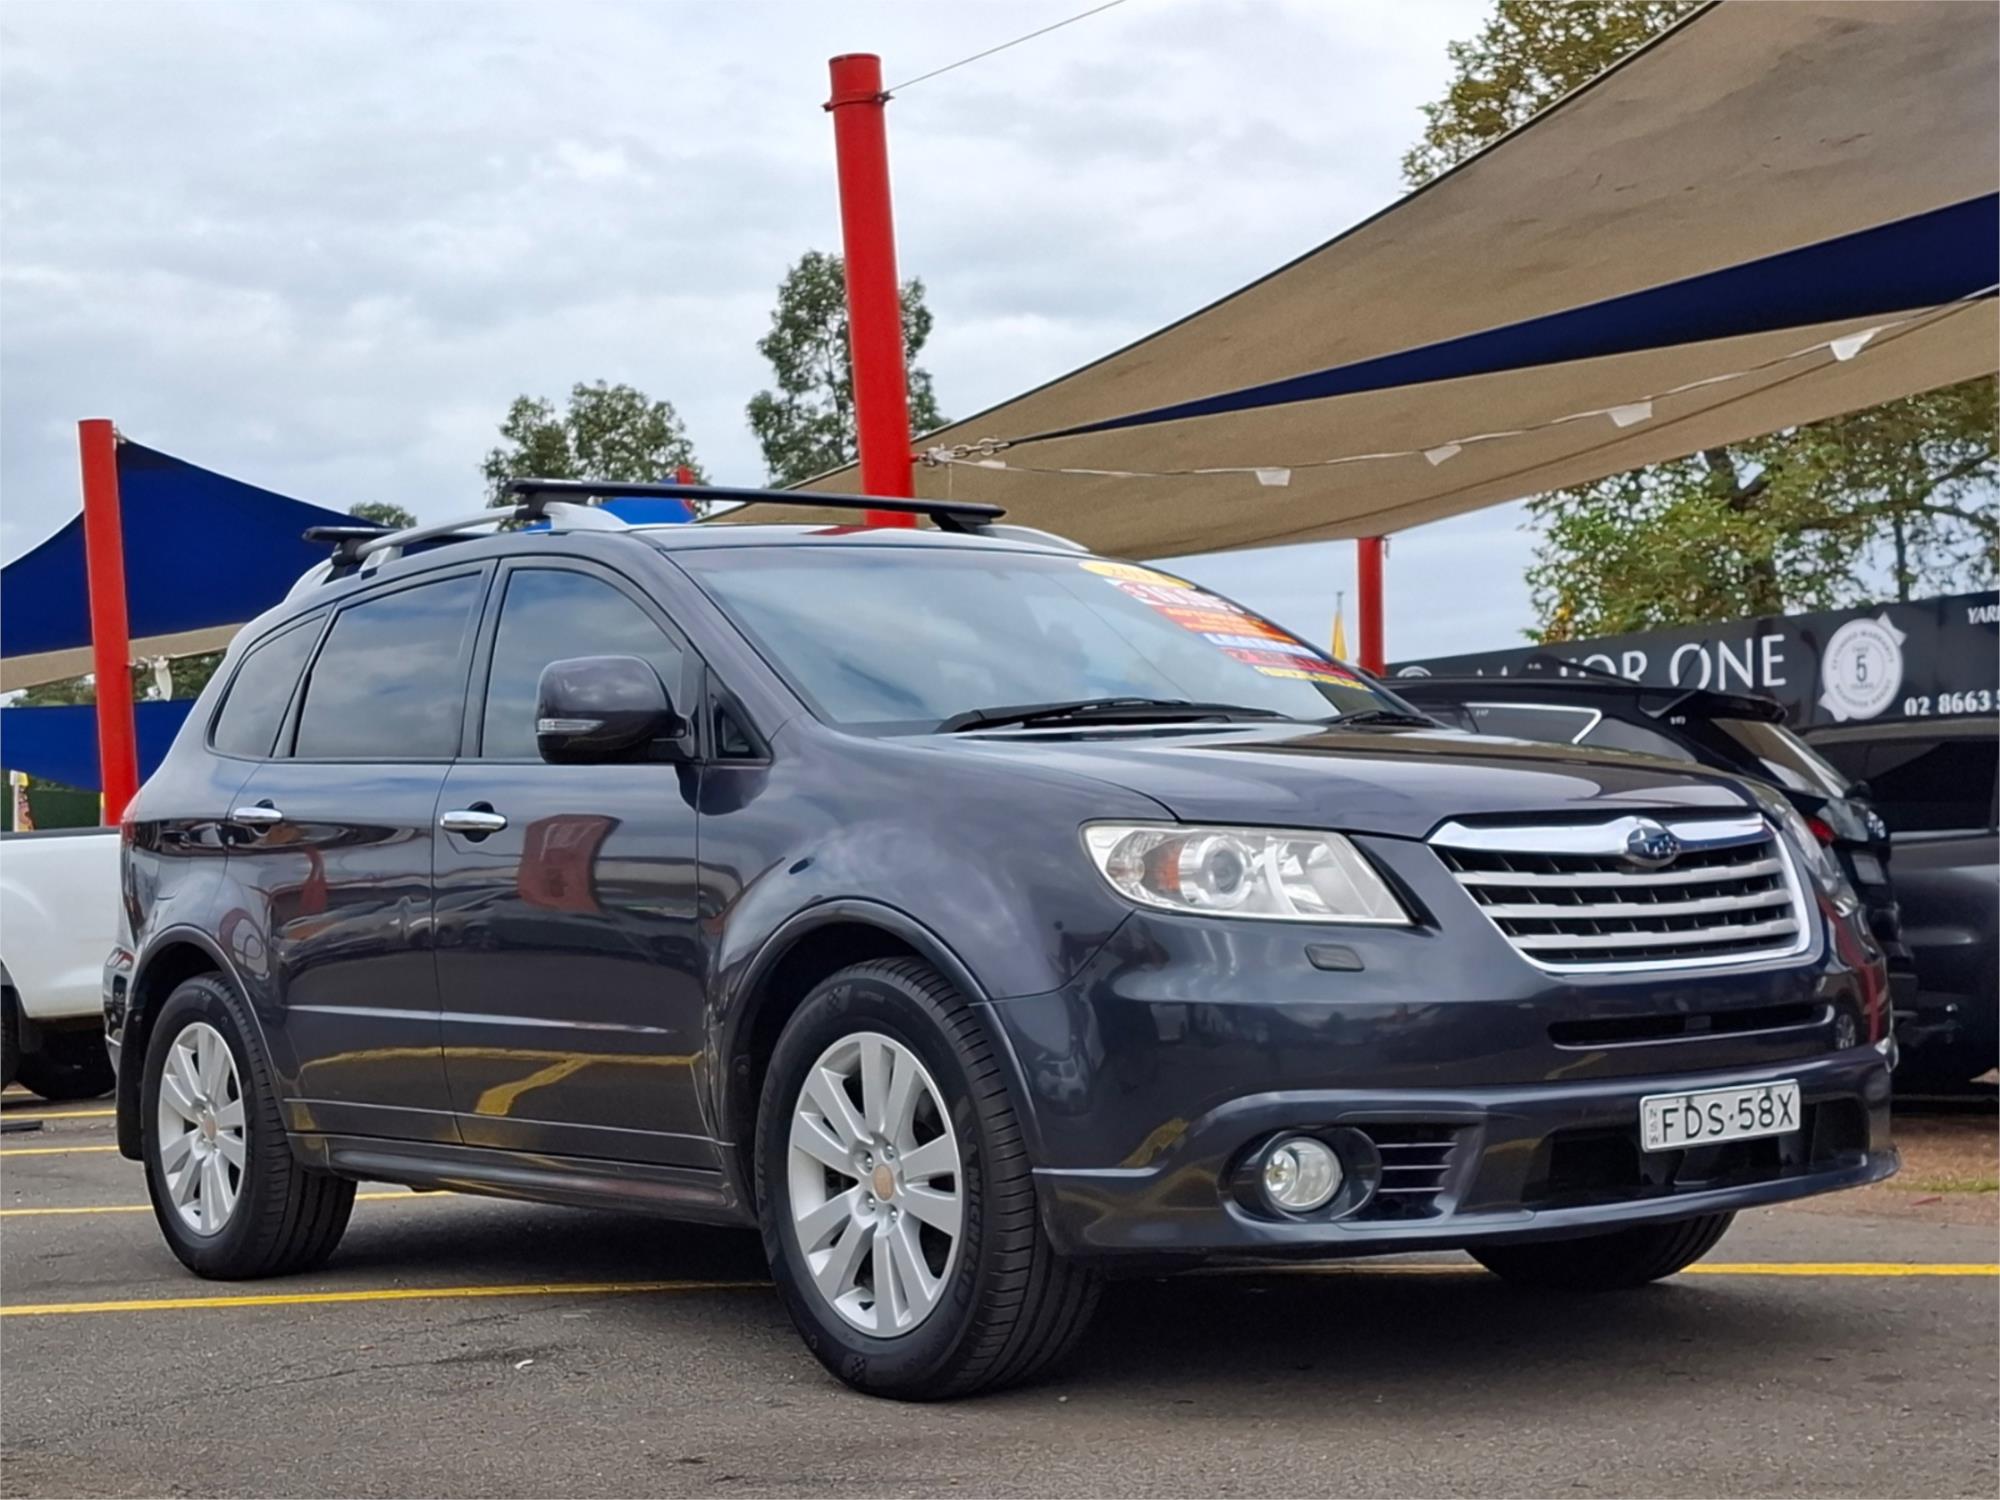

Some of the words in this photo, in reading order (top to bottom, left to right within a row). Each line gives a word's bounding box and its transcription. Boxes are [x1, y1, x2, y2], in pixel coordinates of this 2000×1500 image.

[1967, 605, 1999, 624] YAR
[1670, 634, 1786, 691] ONE
[1856, 654, 1867, 682] 5
[1904, 696, 1930, 716] 02
[1938, 690, 1991, 714] 8663
